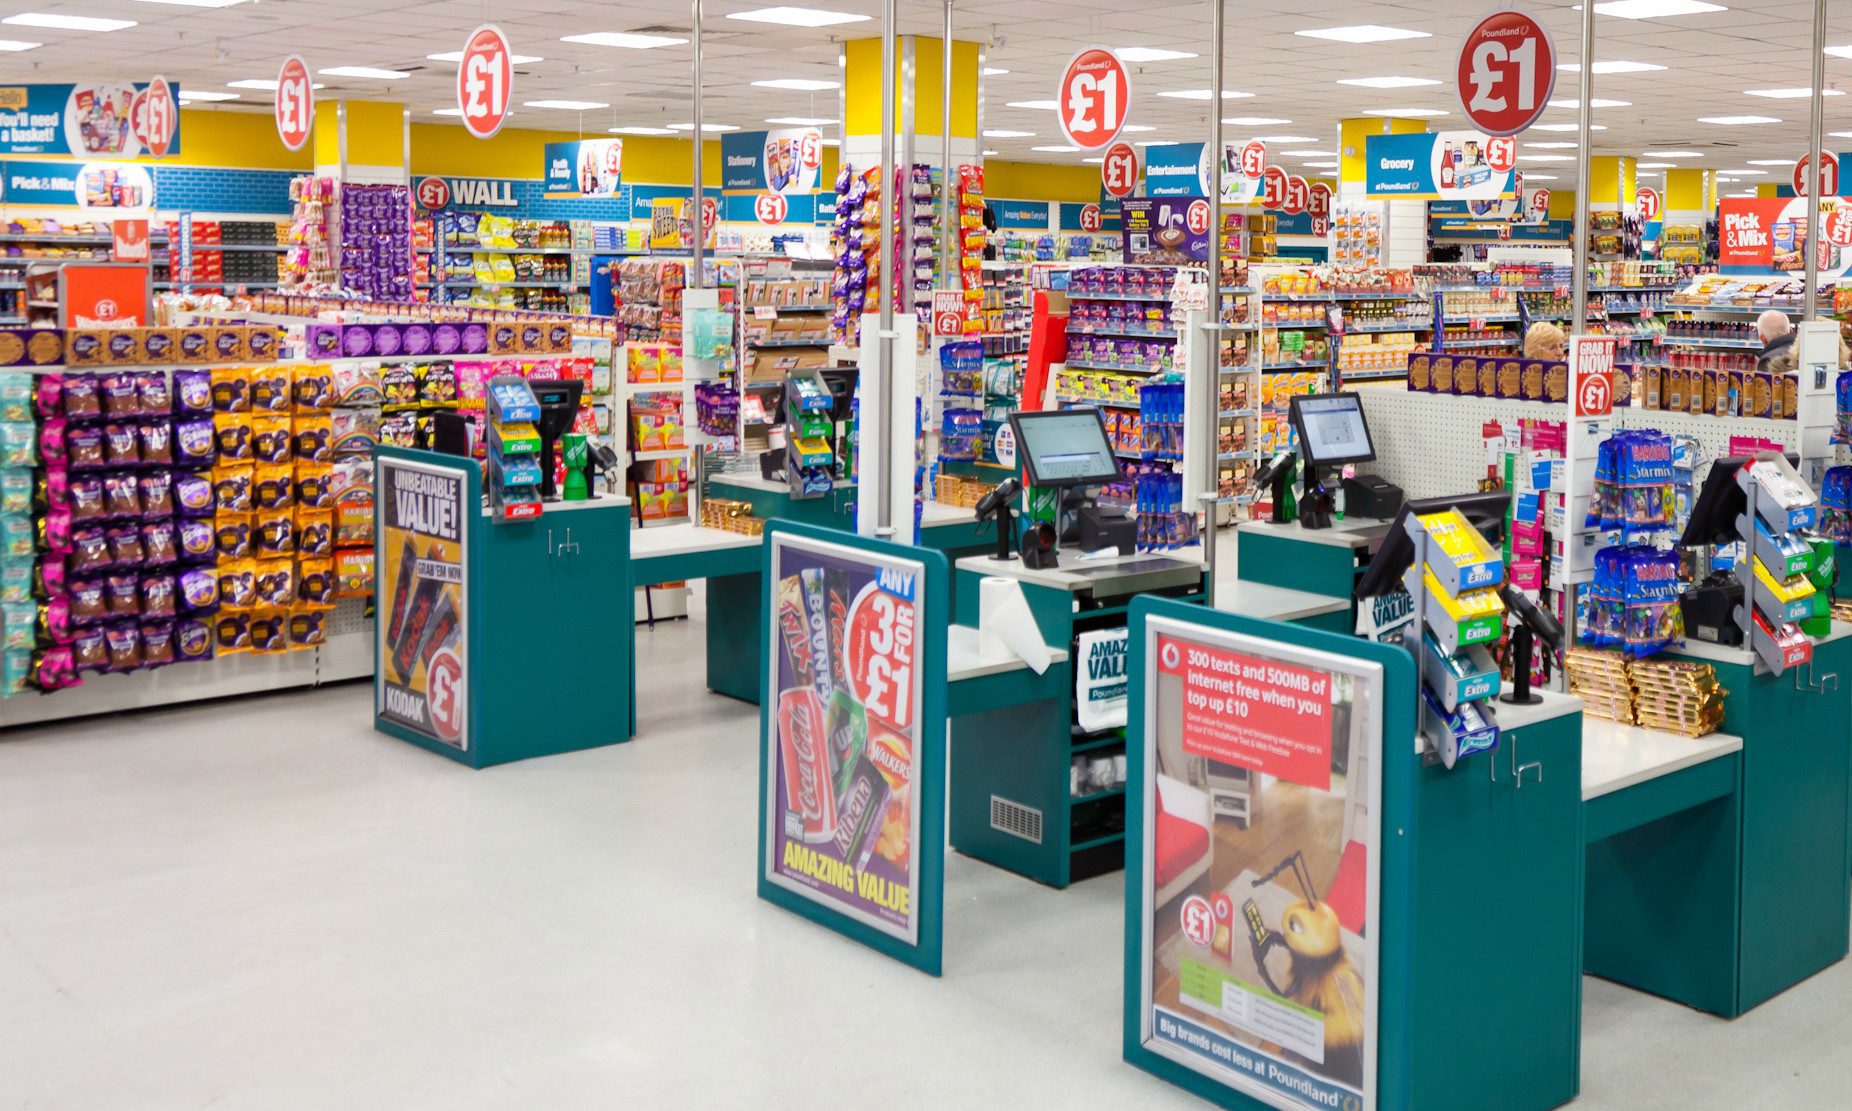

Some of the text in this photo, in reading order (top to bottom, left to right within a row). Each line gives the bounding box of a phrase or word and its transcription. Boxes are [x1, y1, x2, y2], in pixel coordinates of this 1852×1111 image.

[1482, 27, 1520, 37] Poundland
[466, 51, 502, 118] £1
[1470, 37, 1536, 112] £1
[281, 78, 306, 133] £1
[1068, 70, 1116, 133] £1
[30, 112, 58, 126] need
[150, 97, 167, 144] £1
[11, 128, 54, 142] basket!
[608, 147, 621, 170] £1
[728, 155, 756, 168] Stationery
[802, 139, 820, 165] £1
[1242, 150, 1264, 173] £1
[1489, 139, 1516, 166] £1
[1108, 155, 1132, 188] £1
[1147, 164, 1196, 176] Entertainment
[1380, 158, 1414, 170] Grocery
[423, 180, 518, 206] £1 WALL
[1264, 176, 1282, 202] £1
[1283, 186, 1304, 208] £1
[1380, 182, 1411, 190] Poundland
[760, 200, 782, 220] £1
[1309, 192, 1328, 212] £1
[1535, 195, 1548, 208] £1
[1637, 196, 1654, 217] £1
[1084, 210, 1098, 228] £1
[1190, 208, 1208, 229] £1
[1314, 218, 1326, 234] £1
[1725, 212, 1760, 230] Pick
[1832, 225, 1851, 243] £1
[942, 318, 958, 332] £1
[1580, 342, 1614, 355] GRAB IT
[1579, 354, 1614, 374] NOW!
[1586, 386, 1604, 410] £1
[511, 444, 532, 452] Extra
[1632, 444, 1670, 462] HARIBO
[512, 475, 533, 483] Extra
[1636, 464, 1671, 478] Starmix
[394, 469, 455, 499] UNBEATABLE
[396, 490, 457, 540] VALUE!
[512, 507, 535, 515] Extra
[418, 561, 461, 580] GRAB 'EM NOW
[880, 567, 914, 596] ANY
[1468, 571, 1493, 584] Extra
[1372, 596, 1414, 628] VALUE
[830, 589, 847, 682] Mars
[870, 596, 895, 655] 3
[894, 605, 914, 664] FOR
[1466, 627, 1491, 640] Extra
[780, 601, 812, 674] TWIX
[808, 594, 831, 704] BOUNTY
[1090, 639, 1128, 658] AMAZ
[857, 627, 867, 682] Poundland
[1088, 656, 1127, 680] VAL
[1188, 650, 1326, 696] 300 texts and 500MB of
[433, 665, 462, 731] £1
[865, 655, 910, 726] £1
[1188, 670, 1322, 716] internet free when you
[1464, 683, 1490, 697] Extra
[387, 688, 424, 723] KODAK
[1188, 690, 1248, 718] top up £10
[1279, 736, 1293, 748] when
[1294, 741, 1305, 752] you
[1306, 742, 1316, 754] opt
[872, 746, 911, 780] WALKERS
[834, 776, 872, 858] Ribena
[783, 840, 910, 915] AMAZING VALUE
[1187, 906, 1210, 942] £1
[1160, 1018, 1339, 1108] Big brands cost less at Poundland
